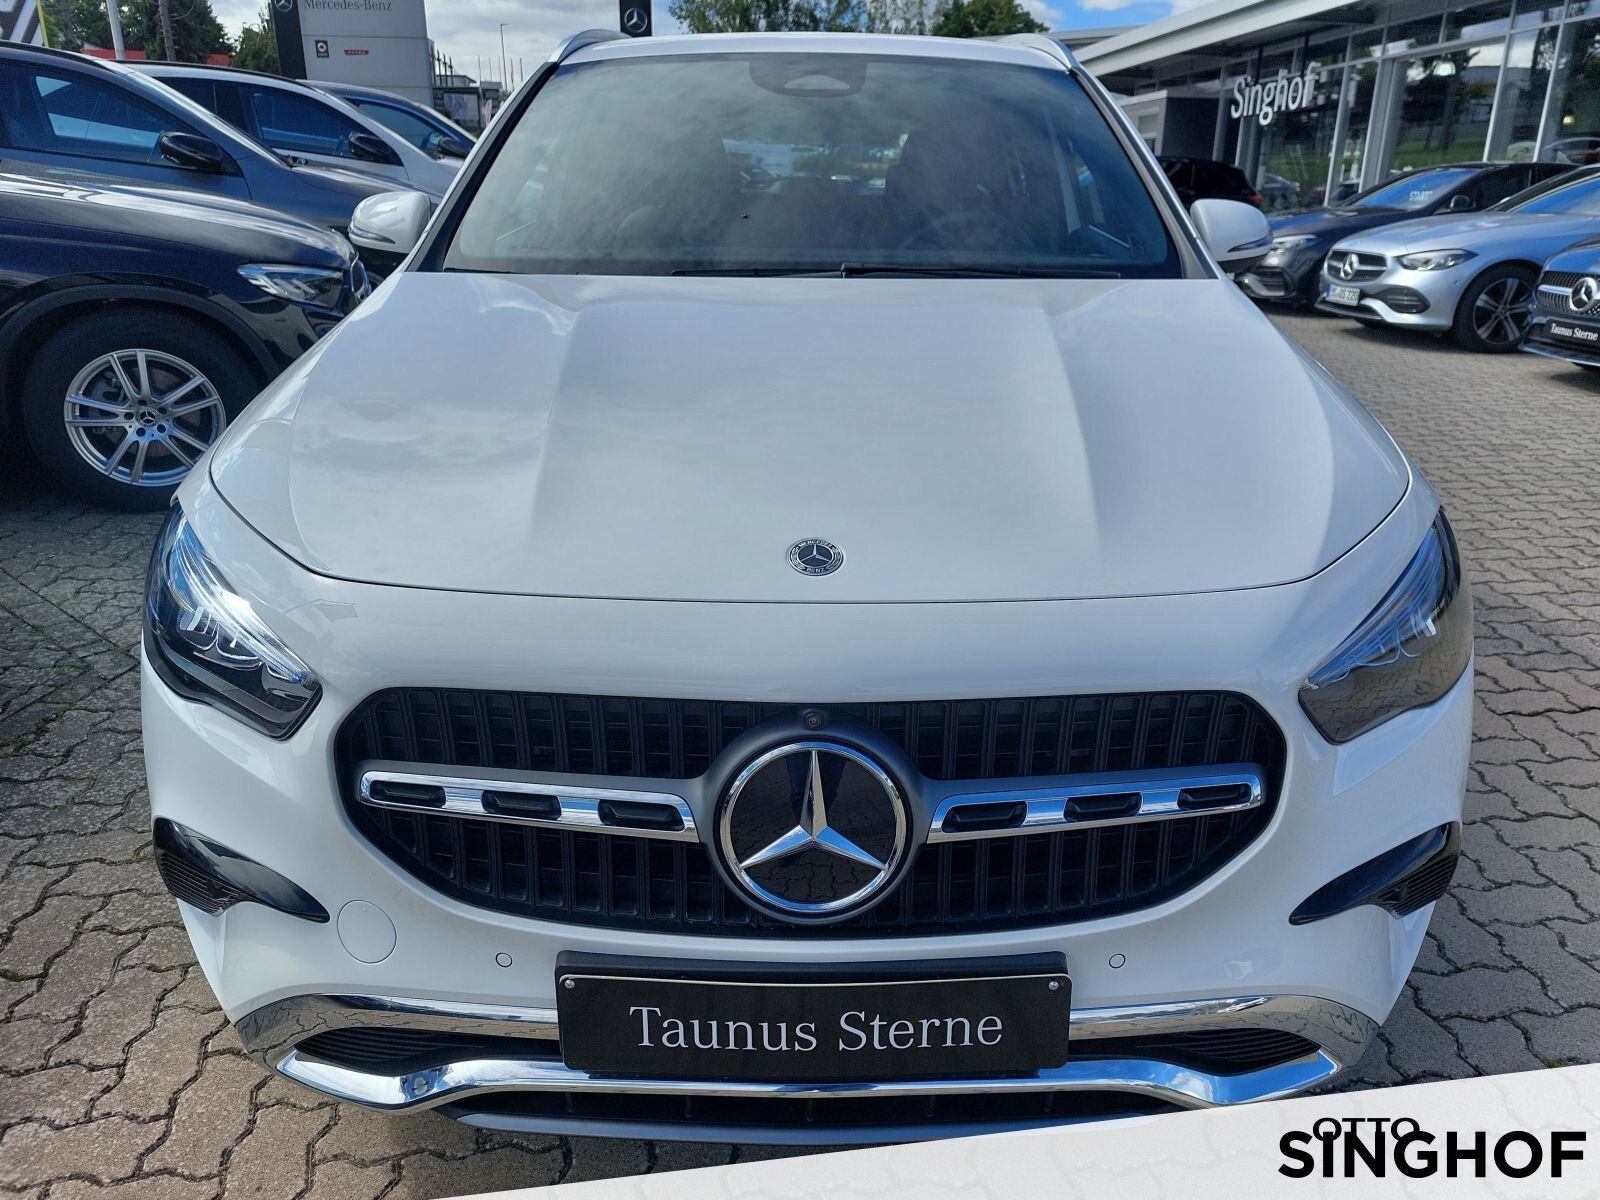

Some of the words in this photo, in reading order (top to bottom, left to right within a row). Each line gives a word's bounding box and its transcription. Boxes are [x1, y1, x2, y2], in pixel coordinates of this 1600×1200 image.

[1231, 62, 1322, 126] Singhof
[1551, 322, 1573, 337] Taunus
[1573, 327, 1599, 341] Sterne
[629, 1006, 818, 1052] Taunus
[838, 1011, 1004, 1052] Sterne
